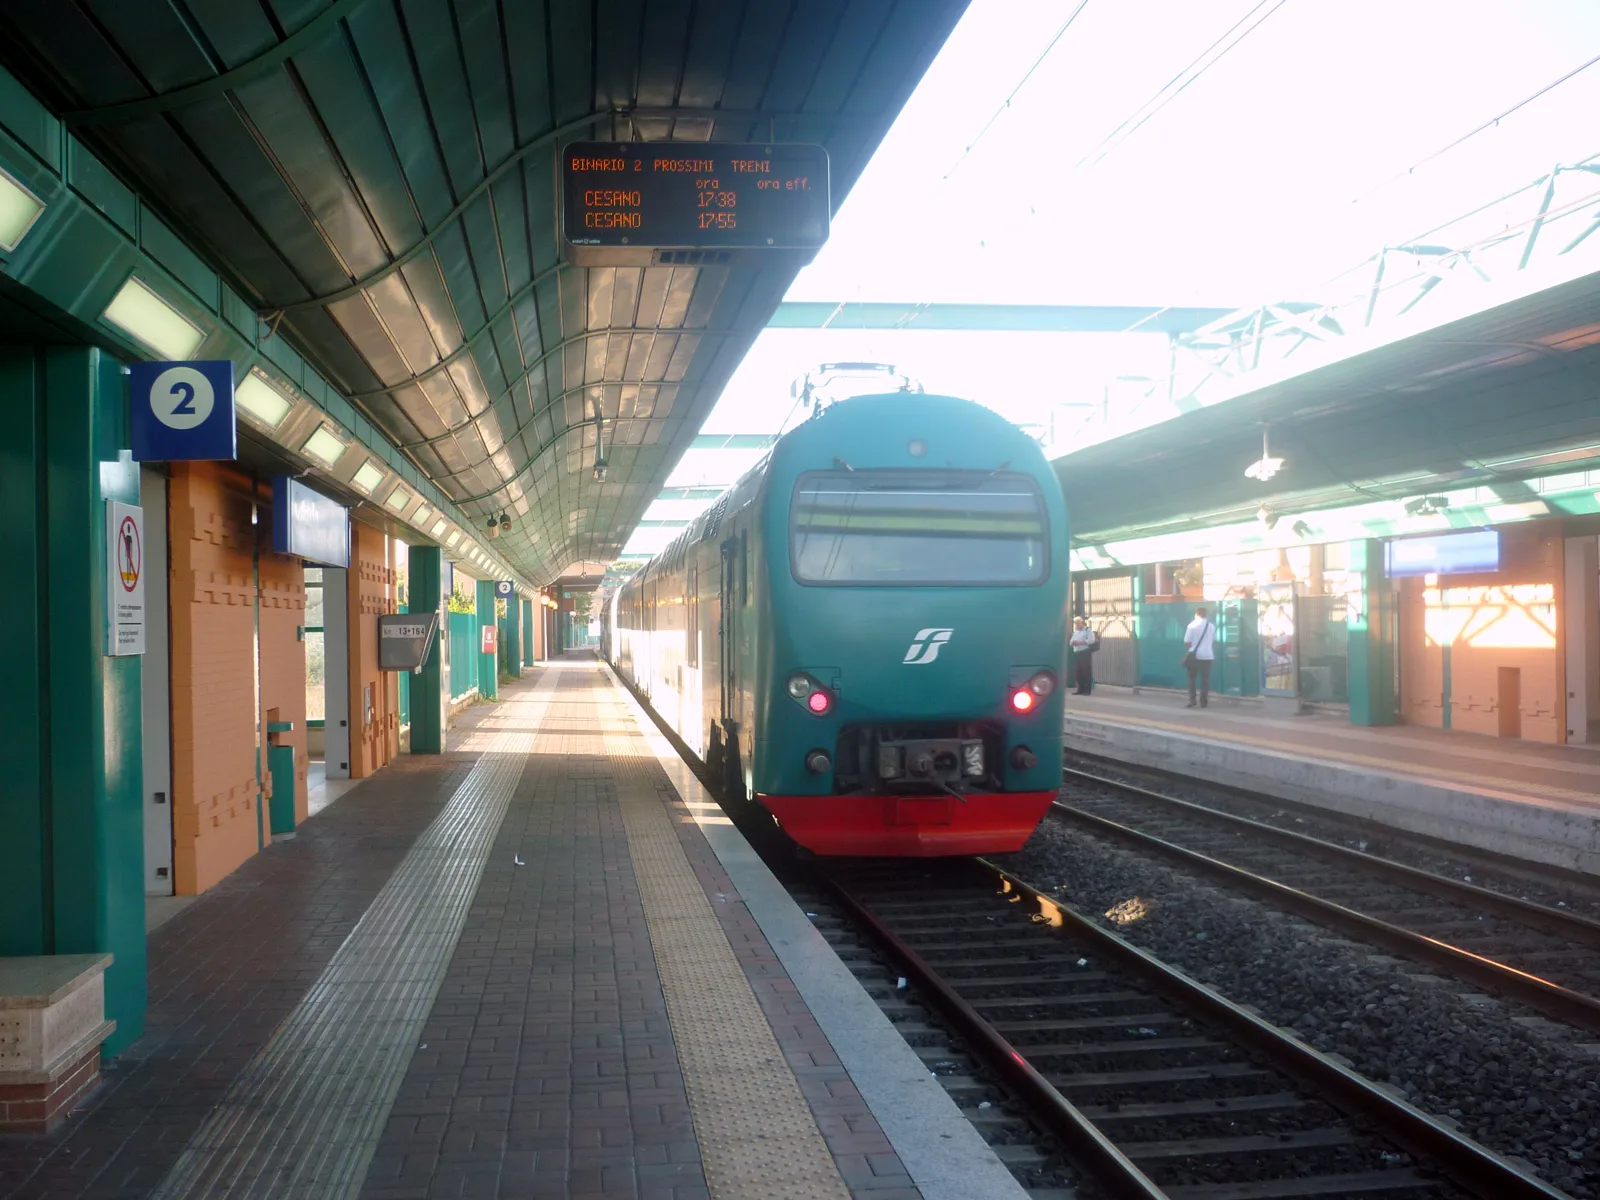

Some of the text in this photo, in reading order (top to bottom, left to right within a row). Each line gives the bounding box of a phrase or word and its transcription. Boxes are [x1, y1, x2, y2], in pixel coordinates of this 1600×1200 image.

[572, 158, 770, 173] BINARIO 2 PROSSIMI TRENI
[696, 178, 719, 189] ora
[757, 177, 813, 190] ora eff.
[585, 191, 736, 208] CESANO 17:38
[585, 212, 737, 229] CESANO 17:55
[170, 382, 195, 415] 2
